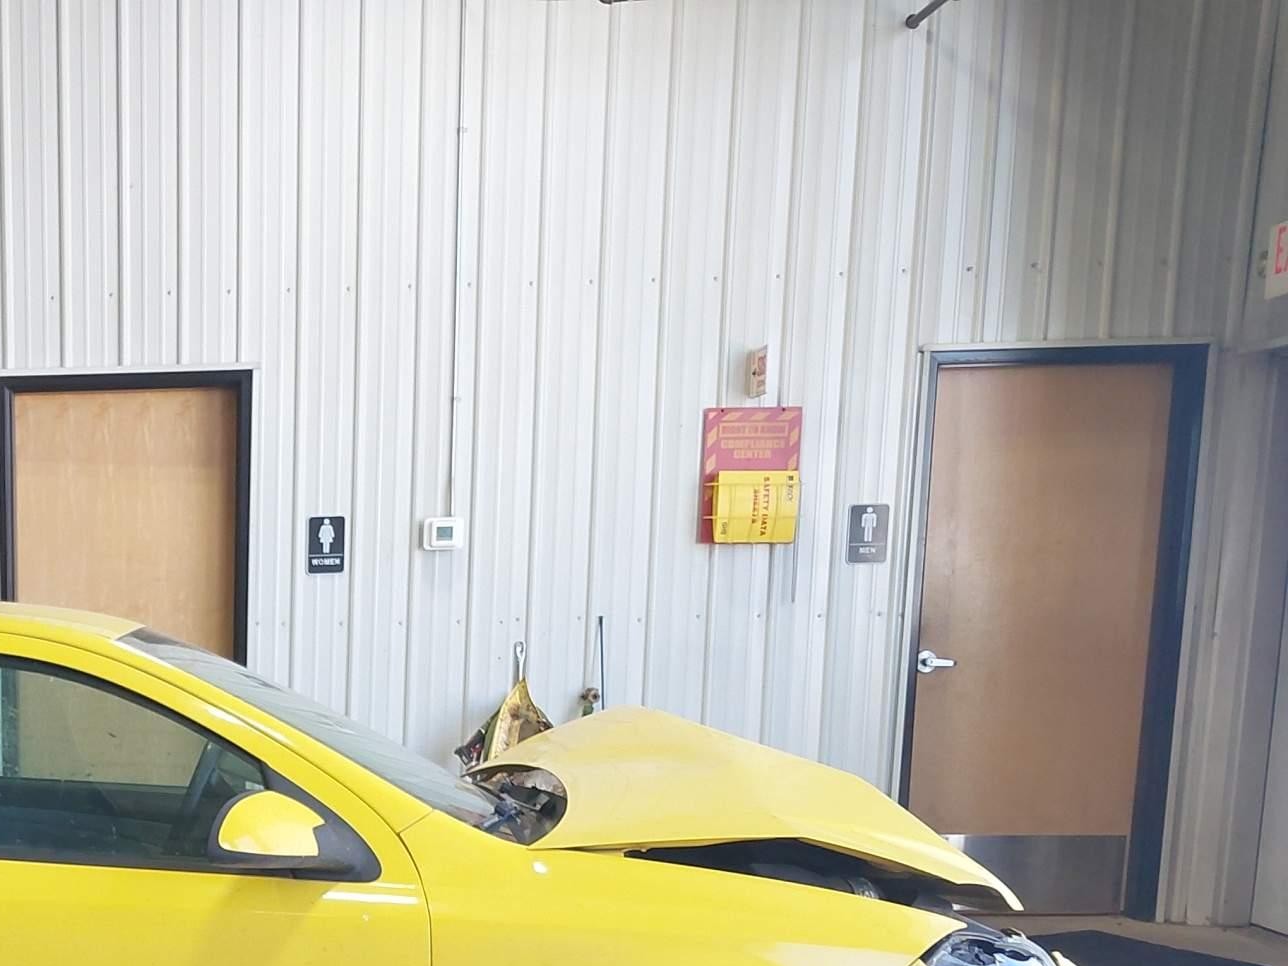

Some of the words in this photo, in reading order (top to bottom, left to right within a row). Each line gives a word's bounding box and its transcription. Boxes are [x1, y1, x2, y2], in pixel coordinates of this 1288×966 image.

[762, 476, 770, 511] SAFETY
[759, 513, 769, 537] DATA
[858, 546, 876, 554] MEN
[311, 557, 340, 567] WOMEN
